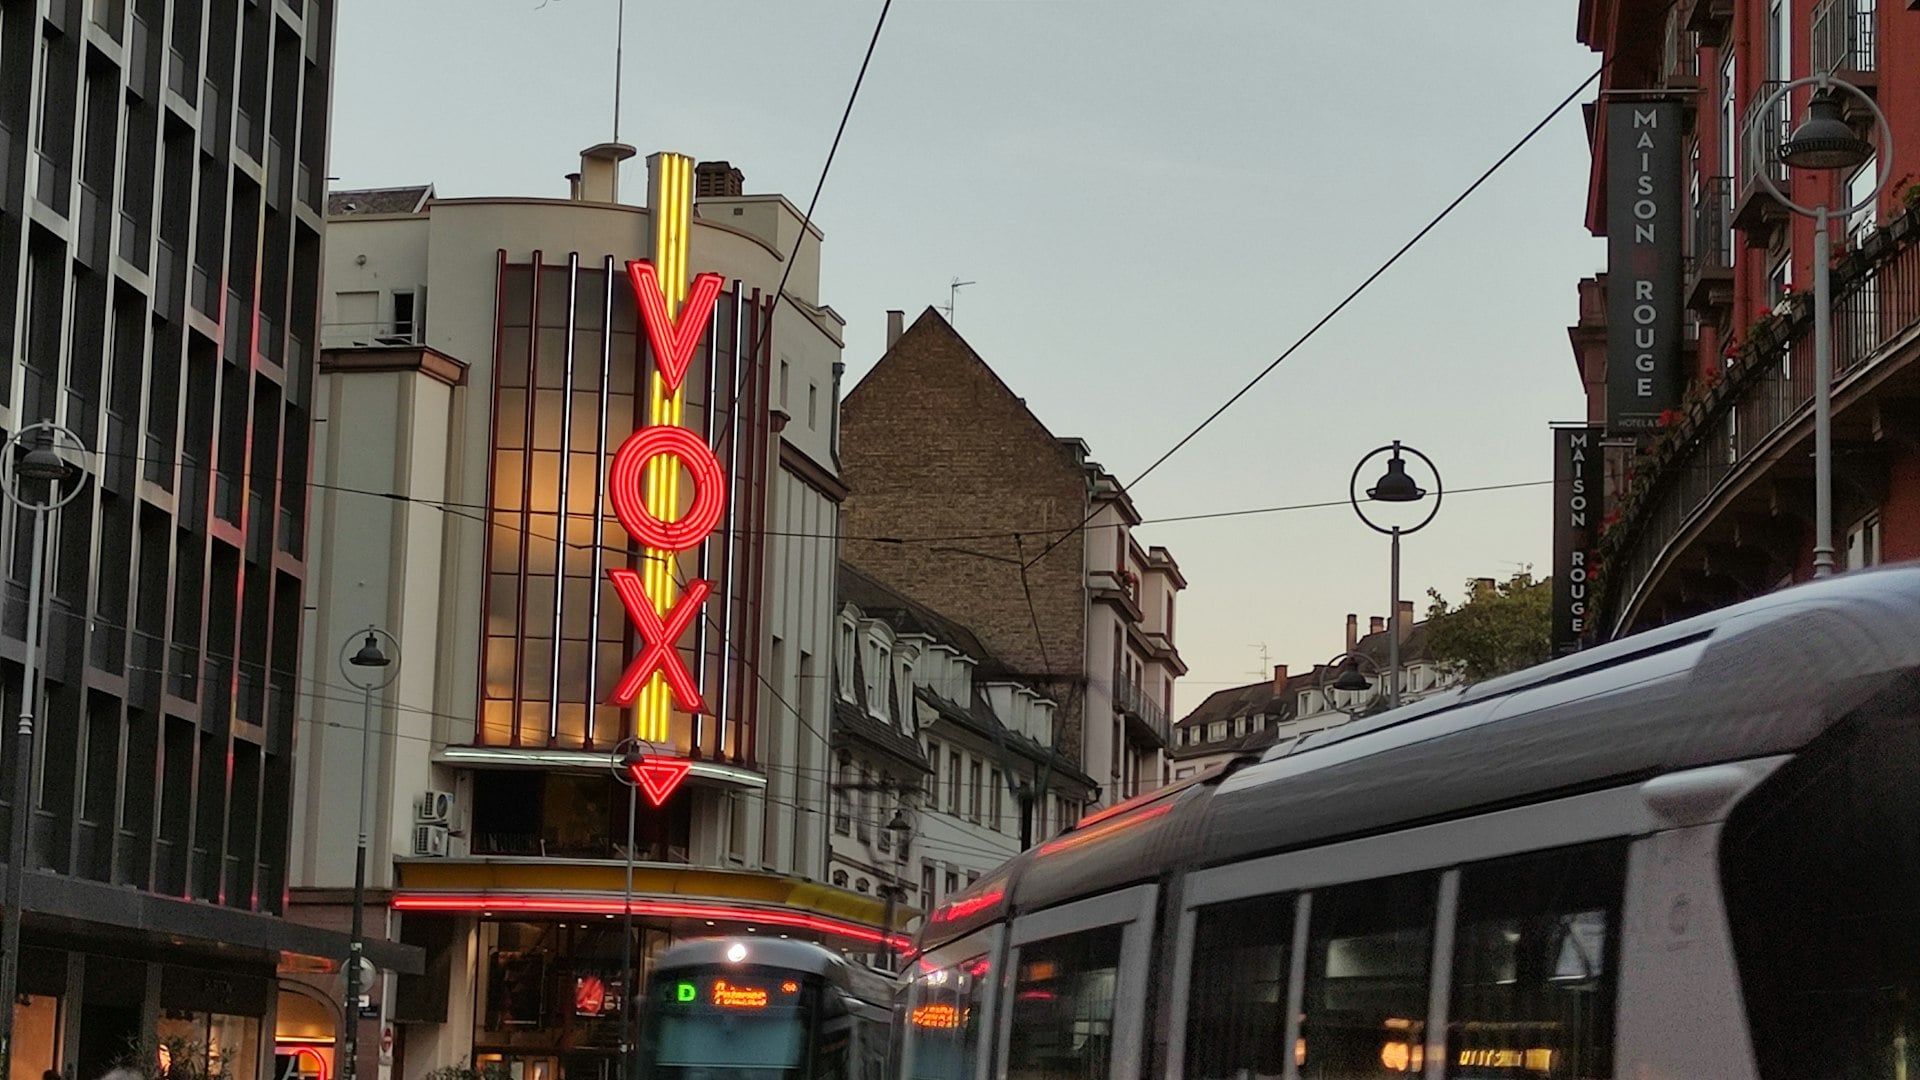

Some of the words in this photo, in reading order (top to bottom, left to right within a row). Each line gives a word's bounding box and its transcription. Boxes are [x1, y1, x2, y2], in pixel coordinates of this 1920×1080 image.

[1633, 108, 1658, 244] MAISON
[1633, 280, 1657, 397] ROUGE
[604, 259, 726, 717] VOX
[1570, 433, 1587, 527] MAISON
[1570, 551, 1586, 632] ROUGE
[678, 984, 696, 1002] D
